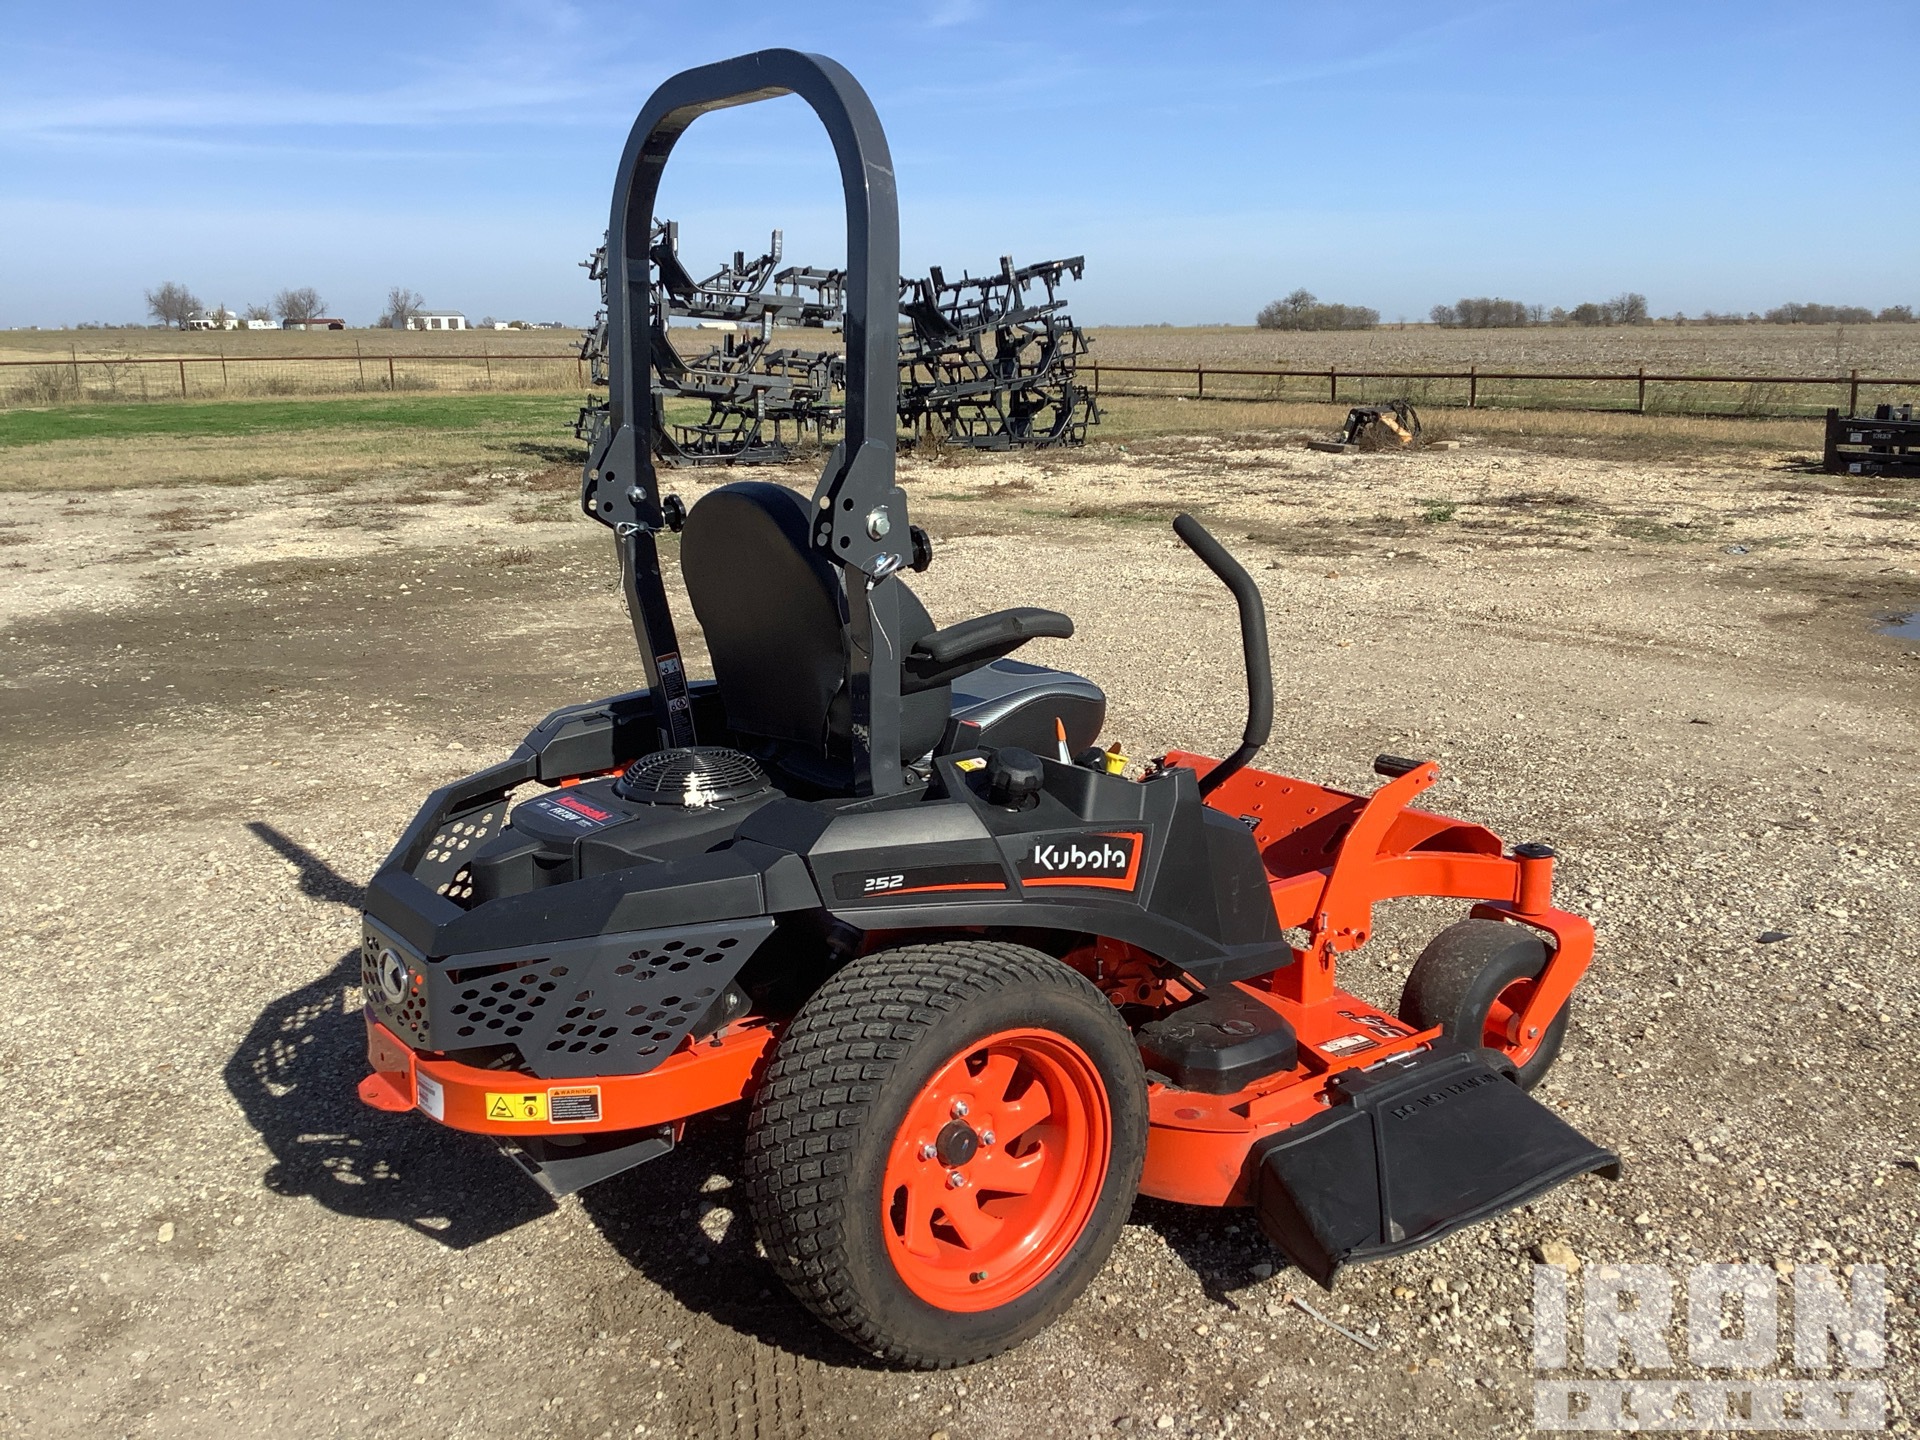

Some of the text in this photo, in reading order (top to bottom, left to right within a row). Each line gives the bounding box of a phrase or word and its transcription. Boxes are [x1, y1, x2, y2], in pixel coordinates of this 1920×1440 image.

[1034, 843, 1127, 871] Kubota
[863, 874, 905, 892] 252
[1391, 1104, 1418, 1120] DO
[1417, 1092, 1448, 1108] NOT
